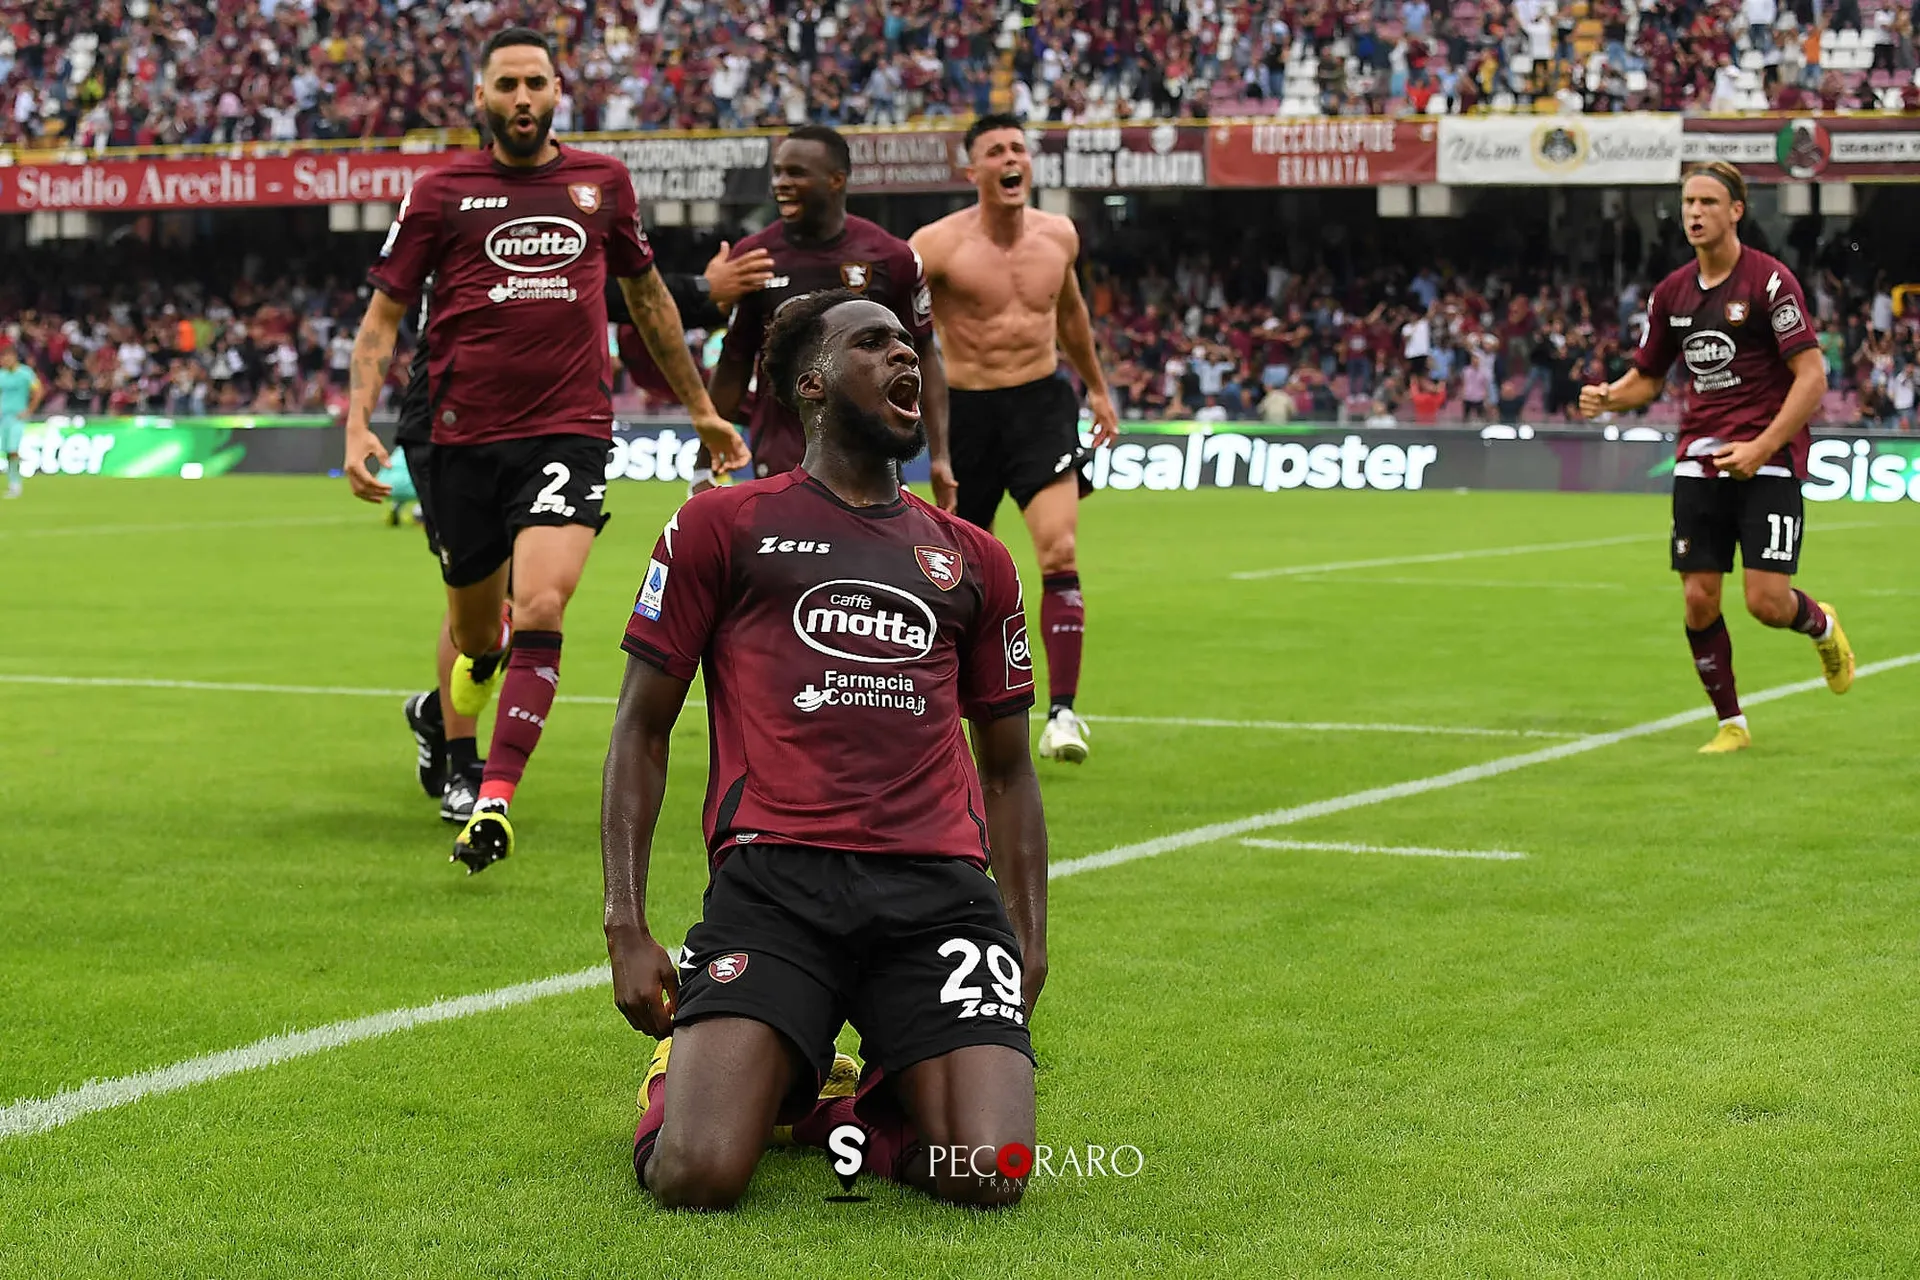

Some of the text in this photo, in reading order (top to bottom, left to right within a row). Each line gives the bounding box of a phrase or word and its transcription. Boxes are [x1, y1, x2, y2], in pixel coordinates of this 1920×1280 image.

[17, 167, 128, 208] Stadio
[138, 161, 257, 204] Arechi
[460, 196, 508, 211] Zeus
[494, 232, 579, 256] motta
[508, 275, 568, 288] Farmacia
[542, 462, 570, 503] 2
[757, 536, 831, 554] Zeus
[1768, 514, 1793, 553] 11
[830, 594, 872, 610] caffè
[806, 608, 927, 650] motta
[825, 670, 915, 692] Farmacia
[938, 938, 1021, 1006] 29
[958, 999, 1024, 1025] Zeus
